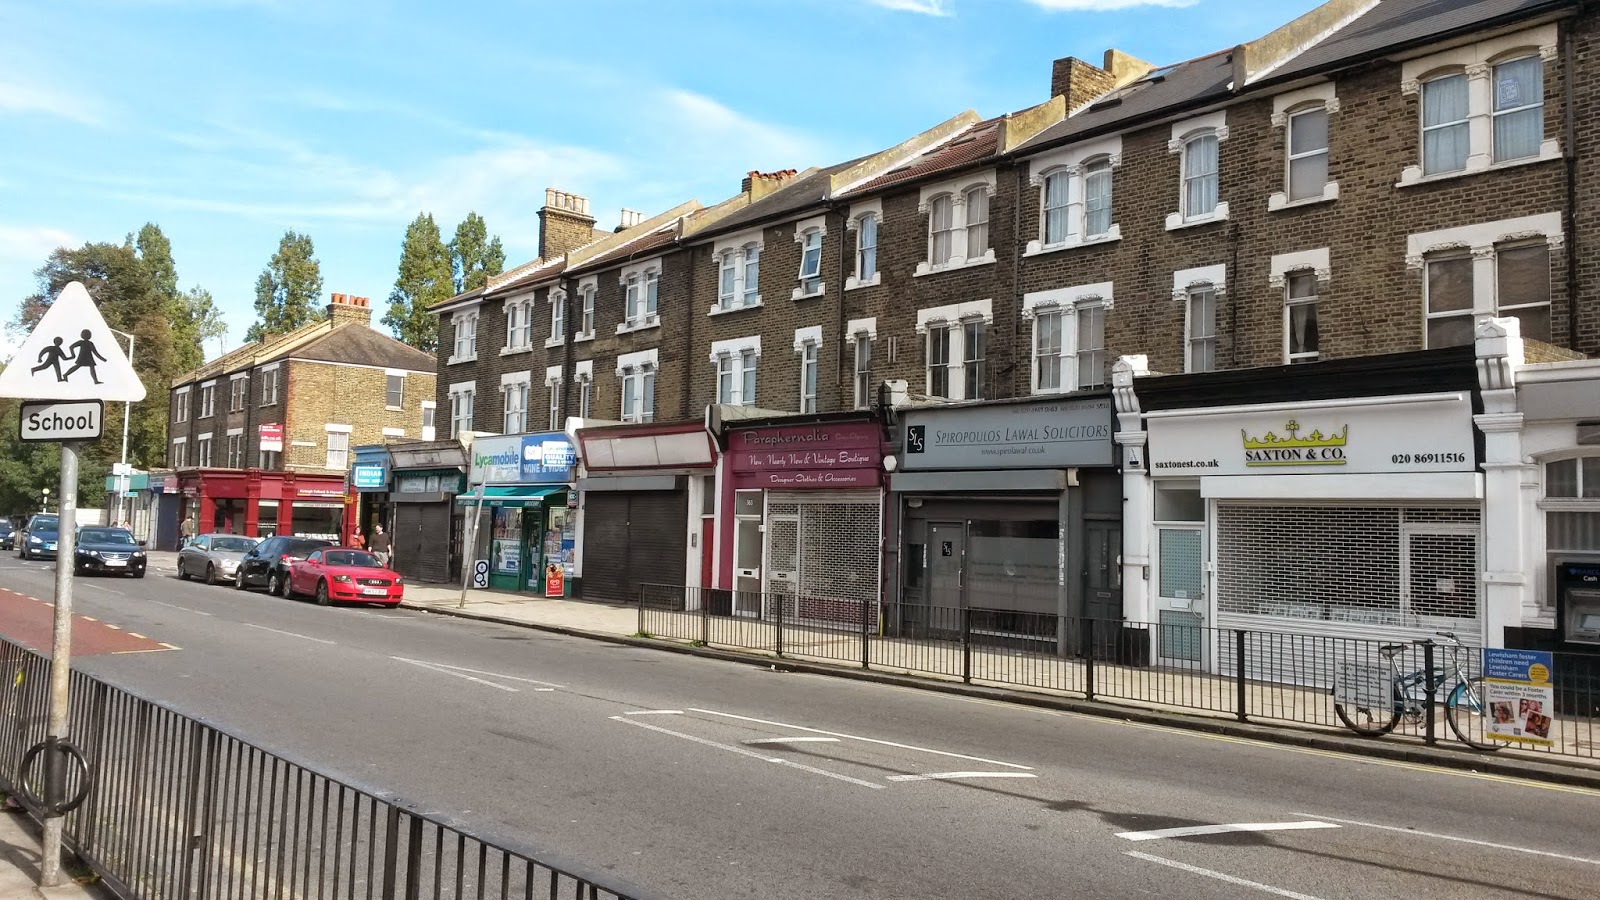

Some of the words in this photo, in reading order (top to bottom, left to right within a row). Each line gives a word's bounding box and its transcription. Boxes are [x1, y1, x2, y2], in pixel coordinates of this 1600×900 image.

[28, 411, 94, 430] School
[742, 430, 829, 447] Paraphernalia
[909, 428, 923, 451] SLS
[1043, 424, 1109, 440] SOLICITORS
[767, 454, 786, 466] Nearly
[788, 454, 803, 465] New
[804, 453, 811, 463] &
[813, 453, 836, 465] Vintage
[838, 451, 870, 464] Boutique
[981, 446, 1046, 456] www.spirolawal.co.uk
[1245, 448, 1301, 462] SAXTON
[1306, 448, 1316, 460] &
[1322, 447, 1346, 460] CO.
[1391, 453, 1411, 464] 020
[1415, 452, 1465, 463] 86911516
[475, 451, 519, 468] Lycamobile
[1155, 458, 1219, 469] saxtonest.co.uk
[524, 464, 540, 473] WINE
[770, 475, 794, 484] Designer
[796, 474, 817, 482] Clothes
[818, 473, 823, 481] &
[824, 473, 856, 482] Accessories
